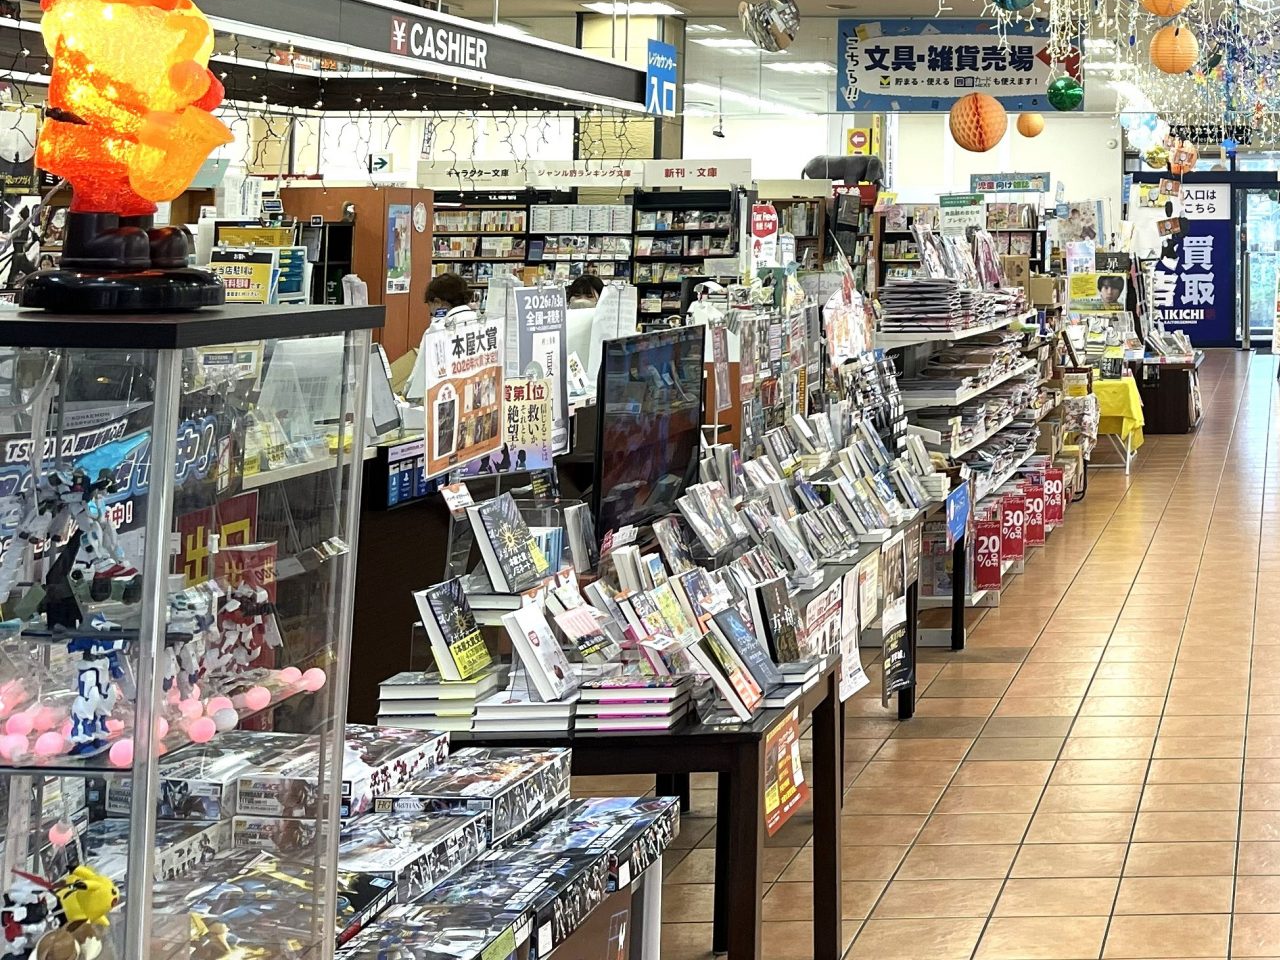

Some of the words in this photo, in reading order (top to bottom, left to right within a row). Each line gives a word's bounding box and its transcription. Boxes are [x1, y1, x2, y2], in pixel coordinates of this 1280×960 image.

[410, 23, 487, 69] CASHIER
[864, 45, 1034, 72] 文具・雑貨売場
[647, 77, 676, 116] 入口
[664, 167, 717, 179] 新刊・文庫
[1184, 190, 1217, 200] 入口は
[1184, 203, 1216, 214] こちら
[1180, 235, 1215, 306] 買取
[1153, 309, 1204, 320] AIKICHI
[451, 326, 498, 359] 本屋大賞
[1044, 479, 1062, 495] 80
[1026, 498, 1044, 513] 50
[1004, 510, 1024, 526] 30
[978, 535, 999, 553] 20
[376, 799, 392, 811] HG
